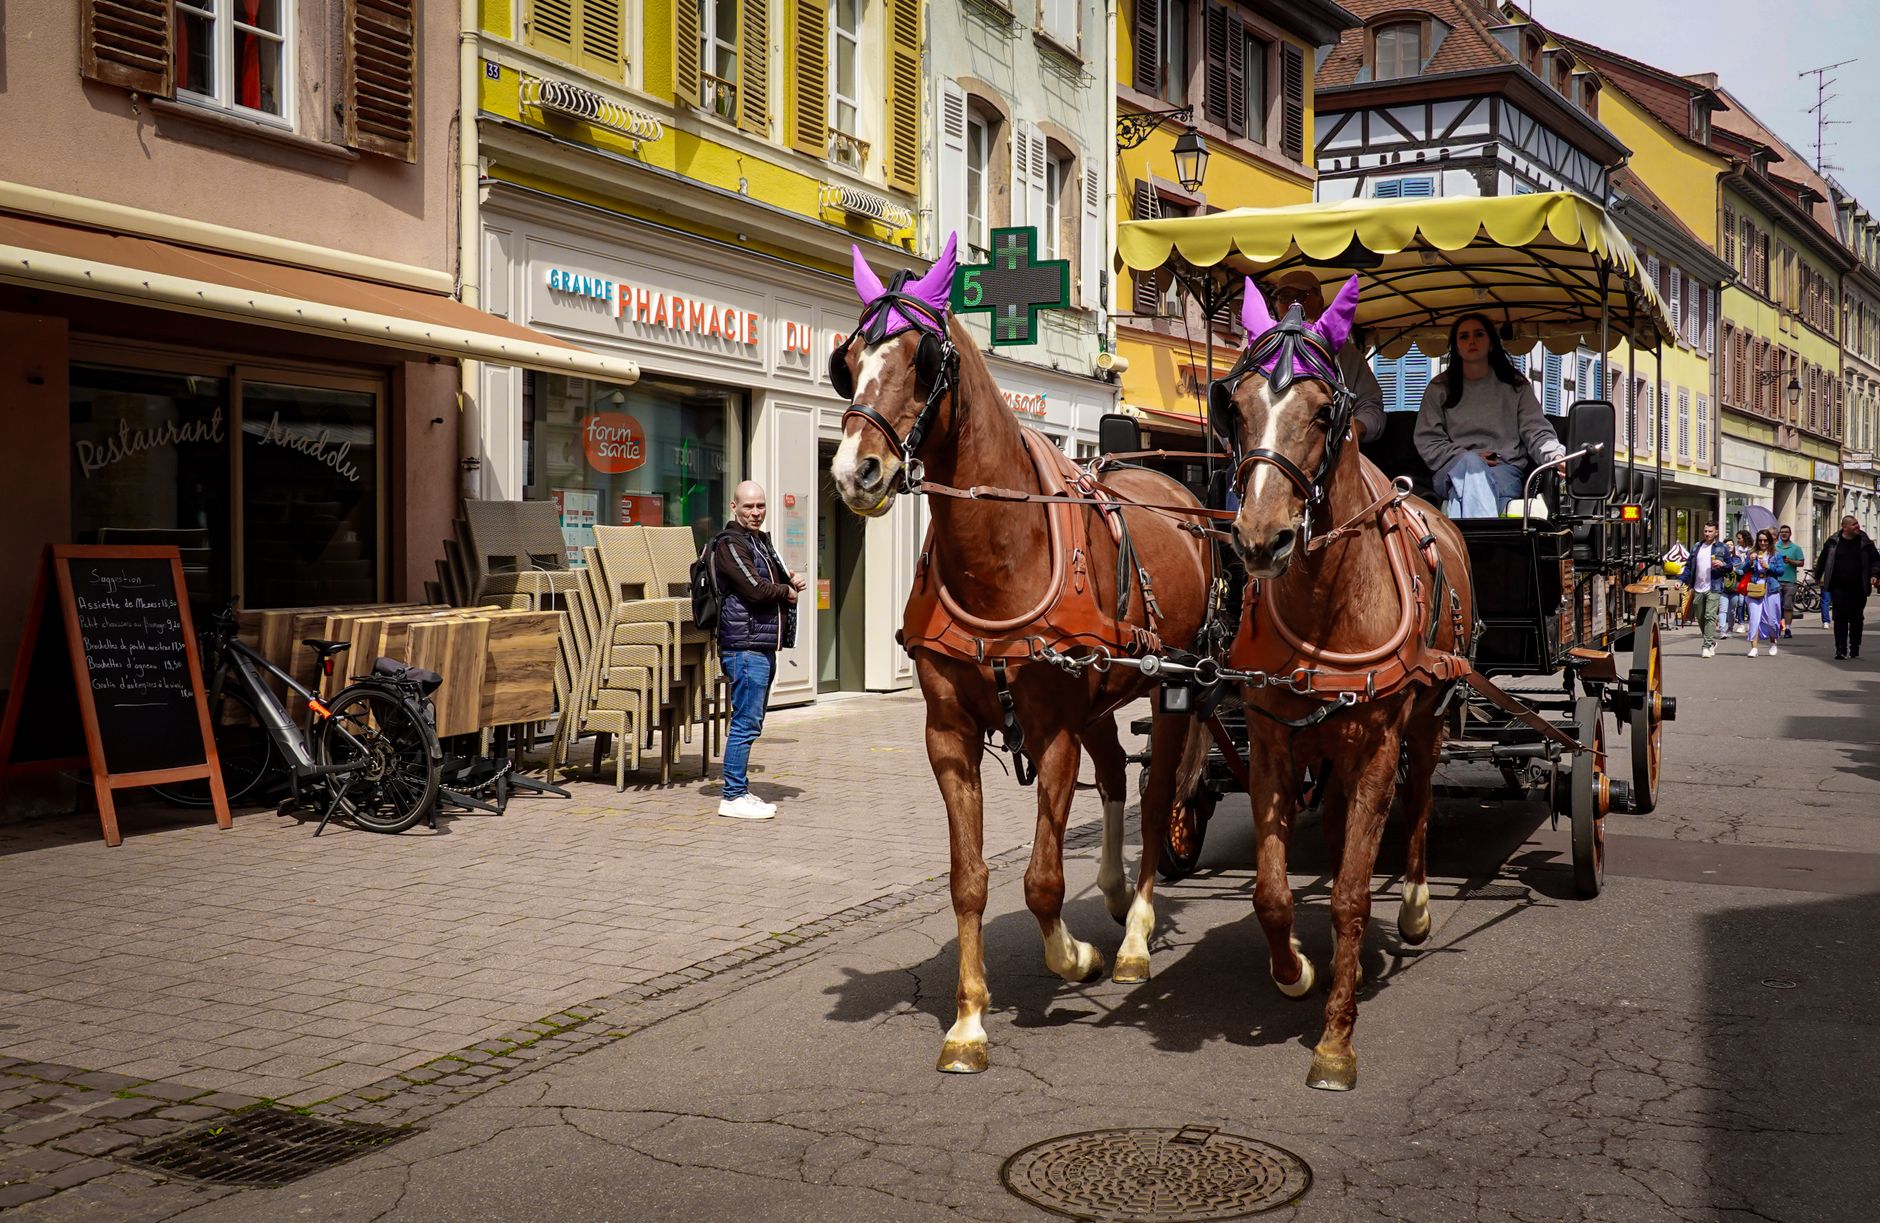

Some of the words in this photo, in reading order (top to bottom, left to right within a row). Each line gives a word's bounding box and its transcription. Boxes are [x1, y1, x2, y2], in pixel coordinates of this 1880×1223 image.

[488, 63, 499, 79] 33
[963, 270, 983, 307] 5
[549, 268, 613, 301] GRANDE
[617, 283, 759, 345] PHARMACIE
[786, 320, 812, 355] DU
[1014, 392, 1048, 417] santé
[586, 416, 632, 443] forum
[75, 406, 225, 480] Restaurant
[258, 410, 369, 483] Anadolu
[597, 440, 641, 460] santé
[89, 568, 142, 594] Suggestion
[78, 596, 121, 610] Assiette
[124, 598, 134, 609] de
